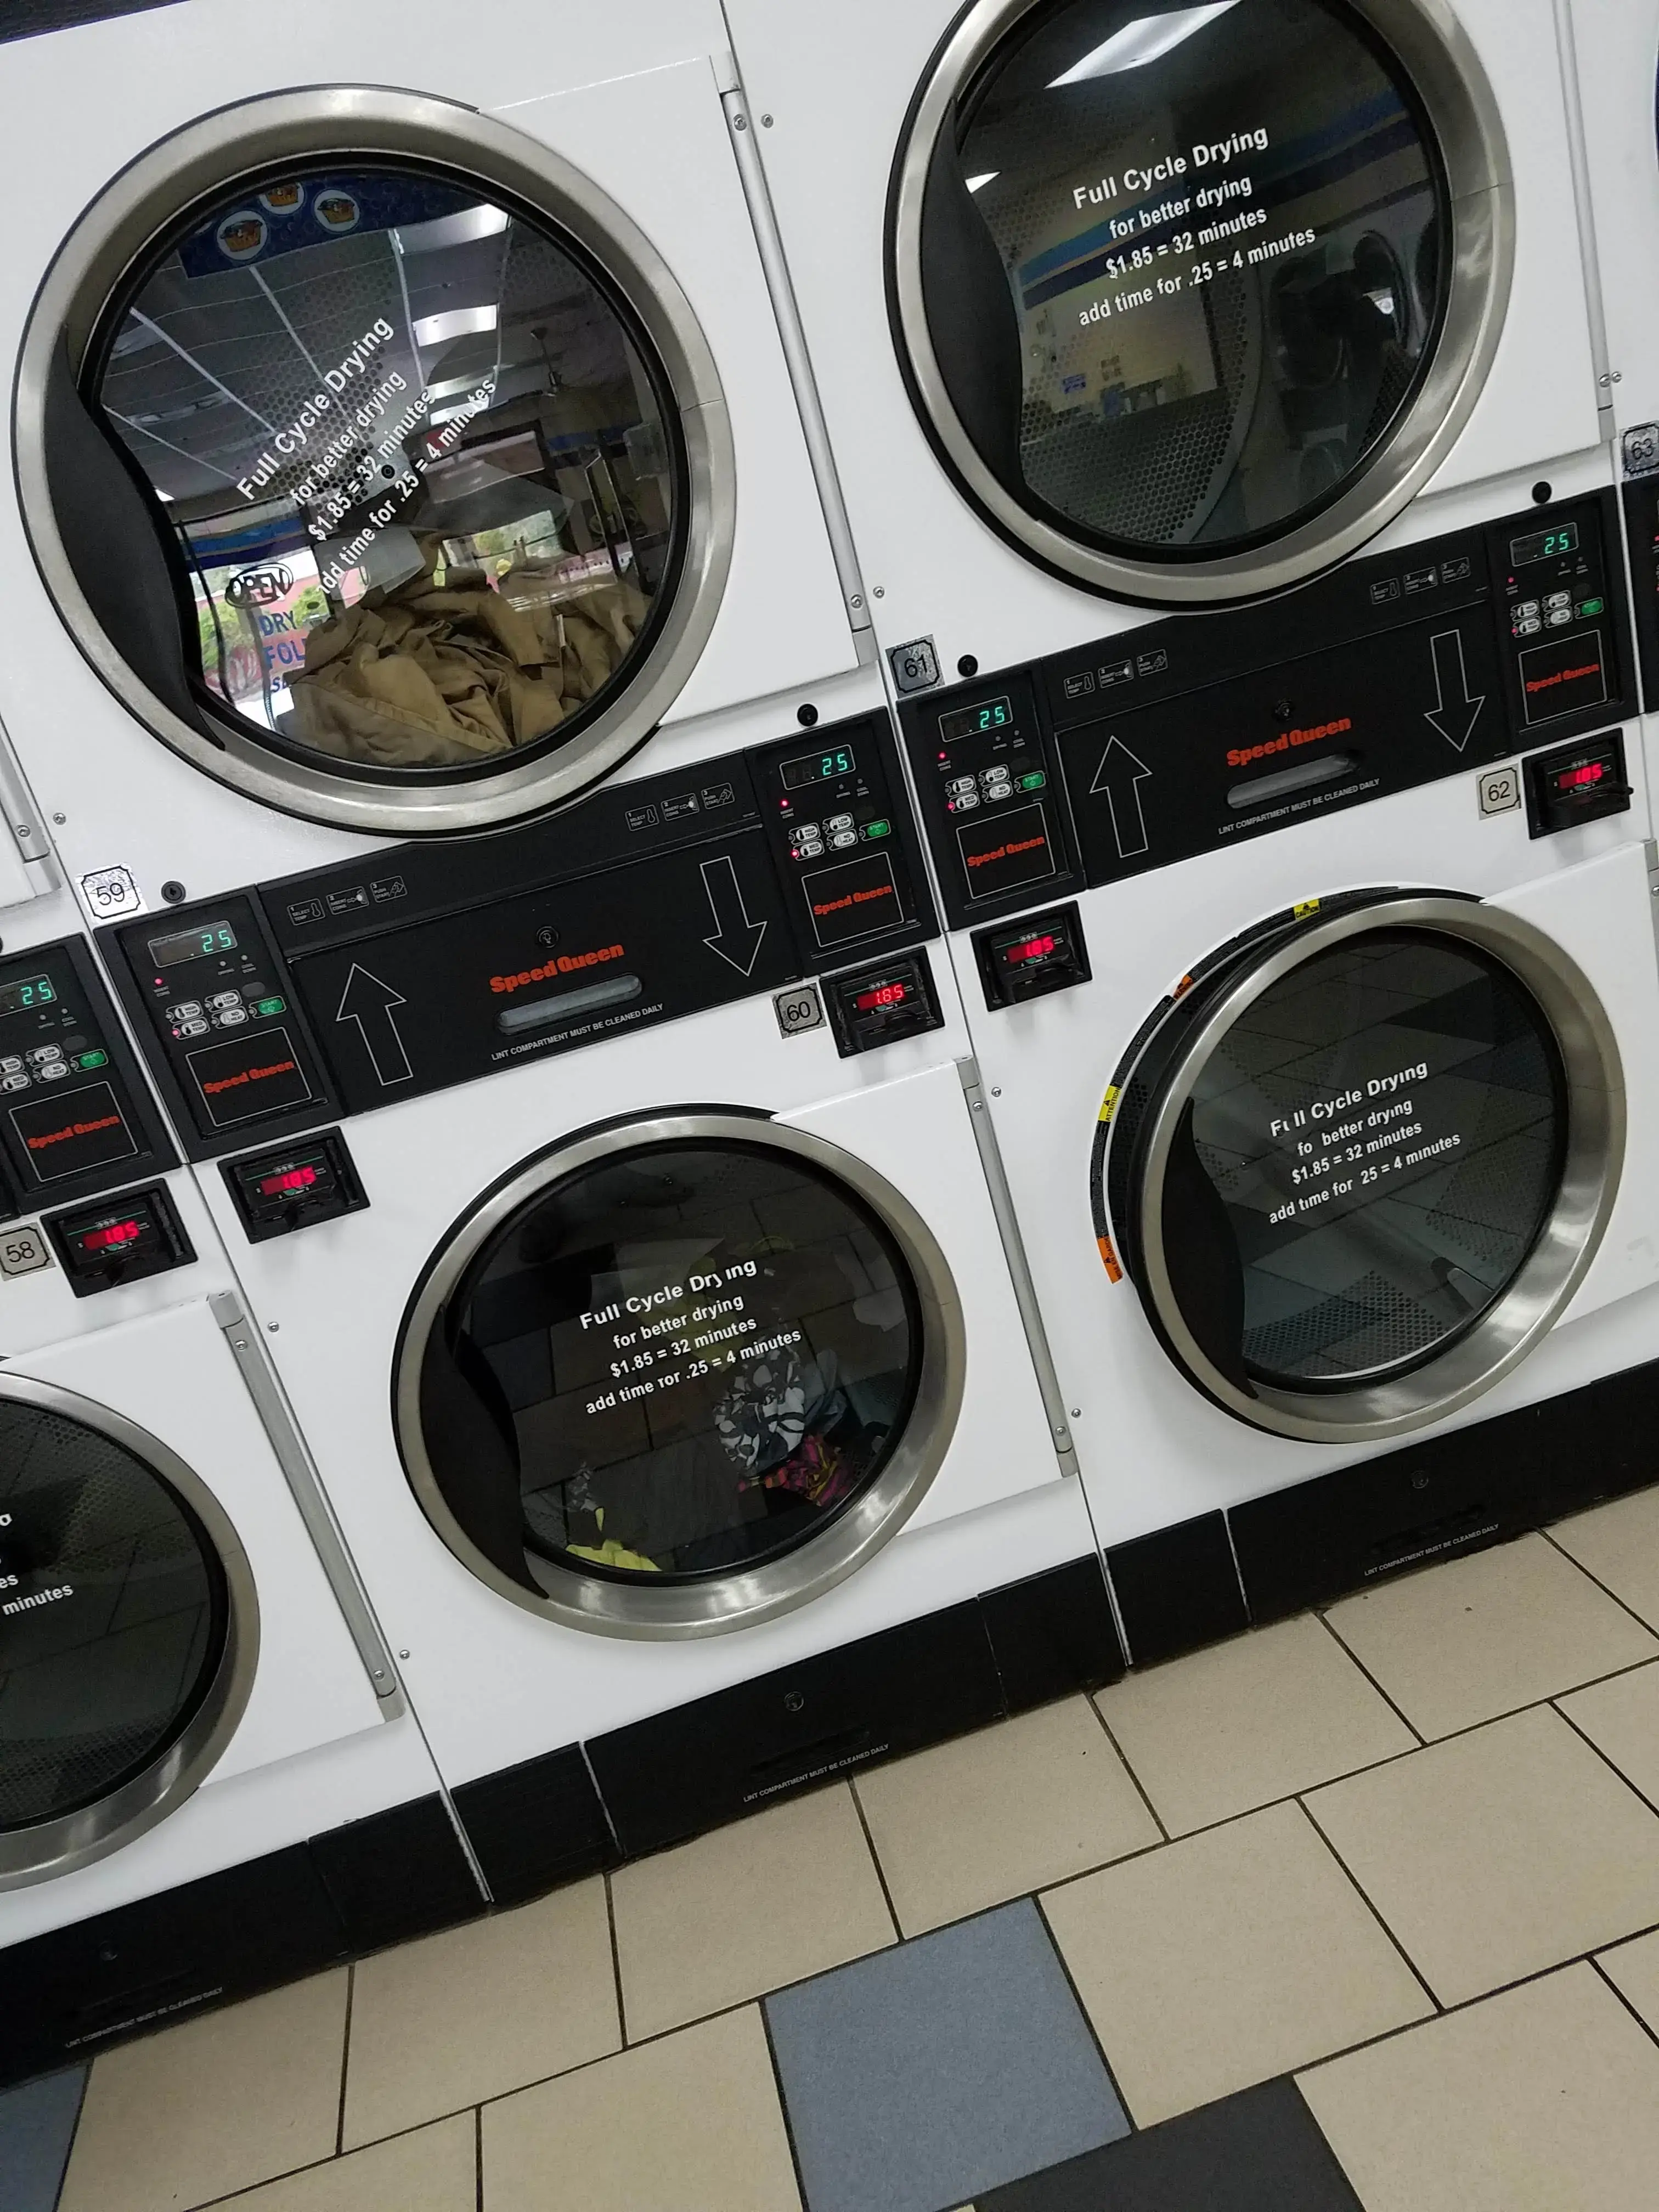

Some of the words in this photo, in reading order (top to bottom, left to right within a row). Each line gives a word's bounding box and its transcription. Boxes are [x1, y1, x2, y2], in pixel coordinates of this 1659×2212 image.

[1073, 177, 1118, 209] Full
[1123, 156, 1187, 191] Cycle
[1192, 127, 1269, 167] Drying
[1109, 218, 1135, 239] for
[1139, 196, 1191, 228] better
[1196, 177, 1252, 208] drying
[1106, 245, 1153, 280] $1.85
[1173, 232, 1194, 254] 32
[1198, 208, 1267, 245] minutes
[1079, 300, 1111, 325] add
[1115, 289, 1153, 313] time
[1156, 275, 1182, 296] for
[1188, 262, 1212, 287] .25
[1232, 250, 1243, 268] 4
[1247, 228, 1316, 264] minutes
[236, 453, 280, 500] Full
[275, 393, 330, 454] Cycle
[324, 317, 394, 393] Drying
[290, 476, 316, 505] for
[315, 426, 358, 479] better
[356, 371, 407, 427] drying
[1632, 438, 1654, 460] 63
[308, 492, 352, 541] $1.85
[357, 455, 382, 481] 32
[377, 389, 436, 459] minutes
[339, 528, 375, 566] time
[369, 501, 397, 528] for
[400, 471, 420, 502] .25
[425, 442, 441, 461] 4
[438, 380, 496, 448] minutes
[1544, 532, 1570, 555] 25
[258, 611, 297, 636] DRY
[263, 638, 307, 670] FOL
[905, 654, 928, 677] 61
[1525, 673, 1561, 692] Speed
[1563, 663, 1600, 680] Queen
[979, 705, 1006, 729] 25
[822, 753, 848, 776] 25
[1227, 733, 1289, 766] Speed
[1289, 718, 1351, 746] Queen
[1218, 824, 1234, 834] LINT
[1236, 806, 1290, 829] COMPARTMENT
[1291, 800, 1312, 812] MUST
[1312, 797, 1324, 805] BE
[1324, 786, 1358, 802] CLEANED
[1359, 778, 1380, 791] DAILY
[1488, 781, 1510, 802] 62
[967, 847, 1005, 867] Speed
[1006, 836, 1045, 854] Queen
[96, 882, 125, 906] 59
[813, 895, 853, 915] Speed
[853, 885, 893, 903] Queen
[201, 929, 232, 953] 25
[489, 960, 557, 994] Speed
[557, 944, 625, 973] Queen
[20, 981, 53, 1005] 25
[786, 1001, 811, 1022] 60
[491, 1050, 509, 1061] LINT
[511, 1032, 569, 1055] COMPARTMENT
[570, 1025, 591, 1037] MUST
[593, 1022, 605, 1031] BE
[605, 1011, 641, 1027] CLEANED
[642, 1003, 664, 1016] DAILY
[204, 1071, 250, 1094] Speed
[249, 1061, 295, 1080] Queen
[1311, 1090, 1362, 1119] Cycle
[1367, 1062, 1428, 1097] Drying
[1105, 1087, 1121, 1121] ATTENTION
[1322, 1120, 1363, 1147] better
[1367, 1099, 1413, 1127] drying
[27, 1126, 74, 1149] Speed
[74, 1115, 120, 1135] Queen
[1292, 1157, 1330, 1184] $1.85
[1345, 1144, 1363, 1161] 32
[1366, 1122, 1422, 1154] minutes
[1269, 1201, 1296, 1223] add
[1299, 1189, 1330, 1211] time
[1332, 1178, 1353, 1197] for
[1394, 1155, 1403, 1170] 4
[1406, 1133, 1461, 1165] minutes
[6, 1241, 35, 1263] 58
[579, 1304, 621, 1329] Full
[626, 1285, 684, 1313] Cycle
[613, 1332, 636, 1349] for
[640, 1314, 687, 1340] better
[692, 1296, 744, 1322] drying
[610, 1352, 653, 1378] $1.85
[671, 1339, 691, 1356] 32
[694, 1318, 757, 1348] minutes
[585, 1393, 617, 1414] add
[619, 1383, 655, 1402] time
[686, 1359, 709, 1379] .25
[726, 1350, 736, 1364] 4
[740, 1330, 802, 1360] minutes
[1364, 1567, 1378, 1576] LINT
[1379, 1550, 1425, 1571] COMPARTMENT
[1425, 1544, 1442, 1554] MUST
[1453, 1530, 1481, 1544] CLEANED
[1482, 1523, 1499, 1534] DAILY
[2, 1584, 74, 1615] minutes
[743, 1792, 758, 1803] LINT
[759, 1773, 808, 1797] COMPARTMENT
[809, 1766, 828, 1778] MUST
[839, 1751, 870, 1767] CLEANED
[870, 1743, 889, 1755] DAILY
